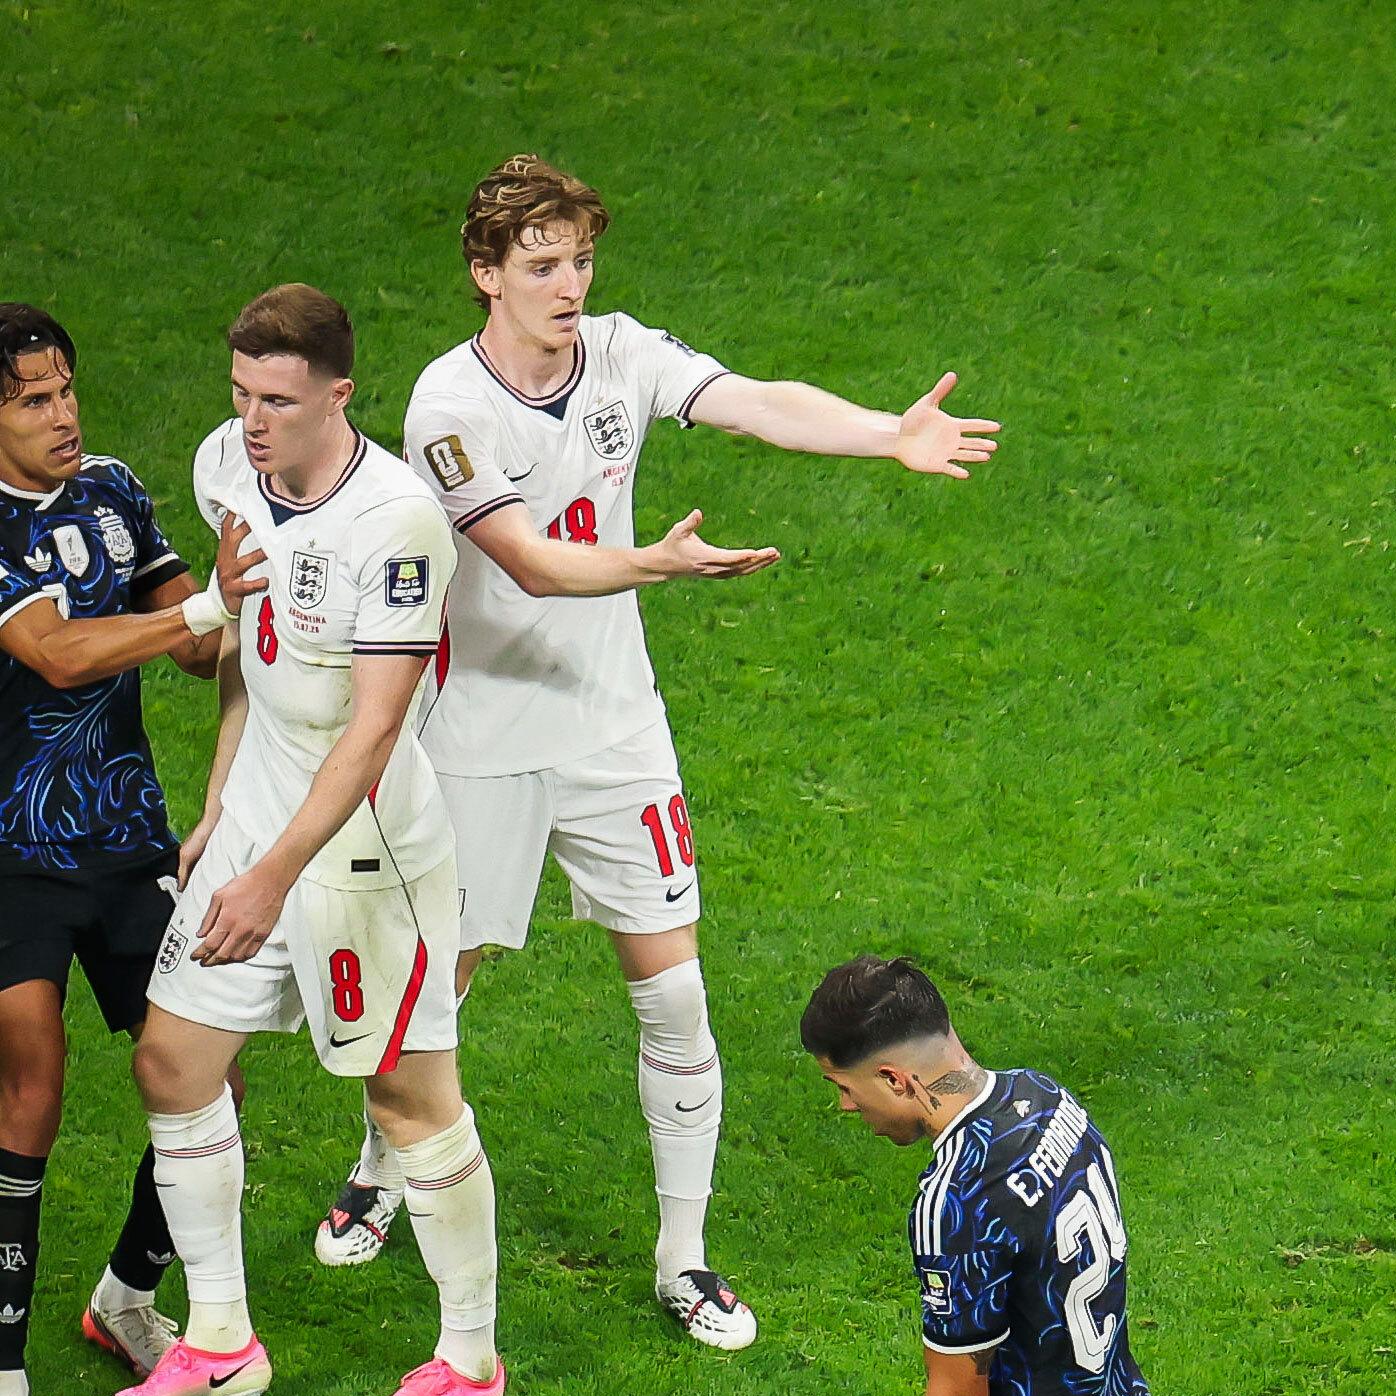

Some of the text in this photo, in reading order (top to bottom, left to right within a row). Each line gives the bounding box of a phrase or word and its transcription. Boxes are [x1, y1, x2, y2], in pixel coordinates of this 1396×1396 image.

[288, 606, 328, 625] ARGENTINA
[640, 794, 693, 878] 18
[330, 948, 364, 1023] 8
